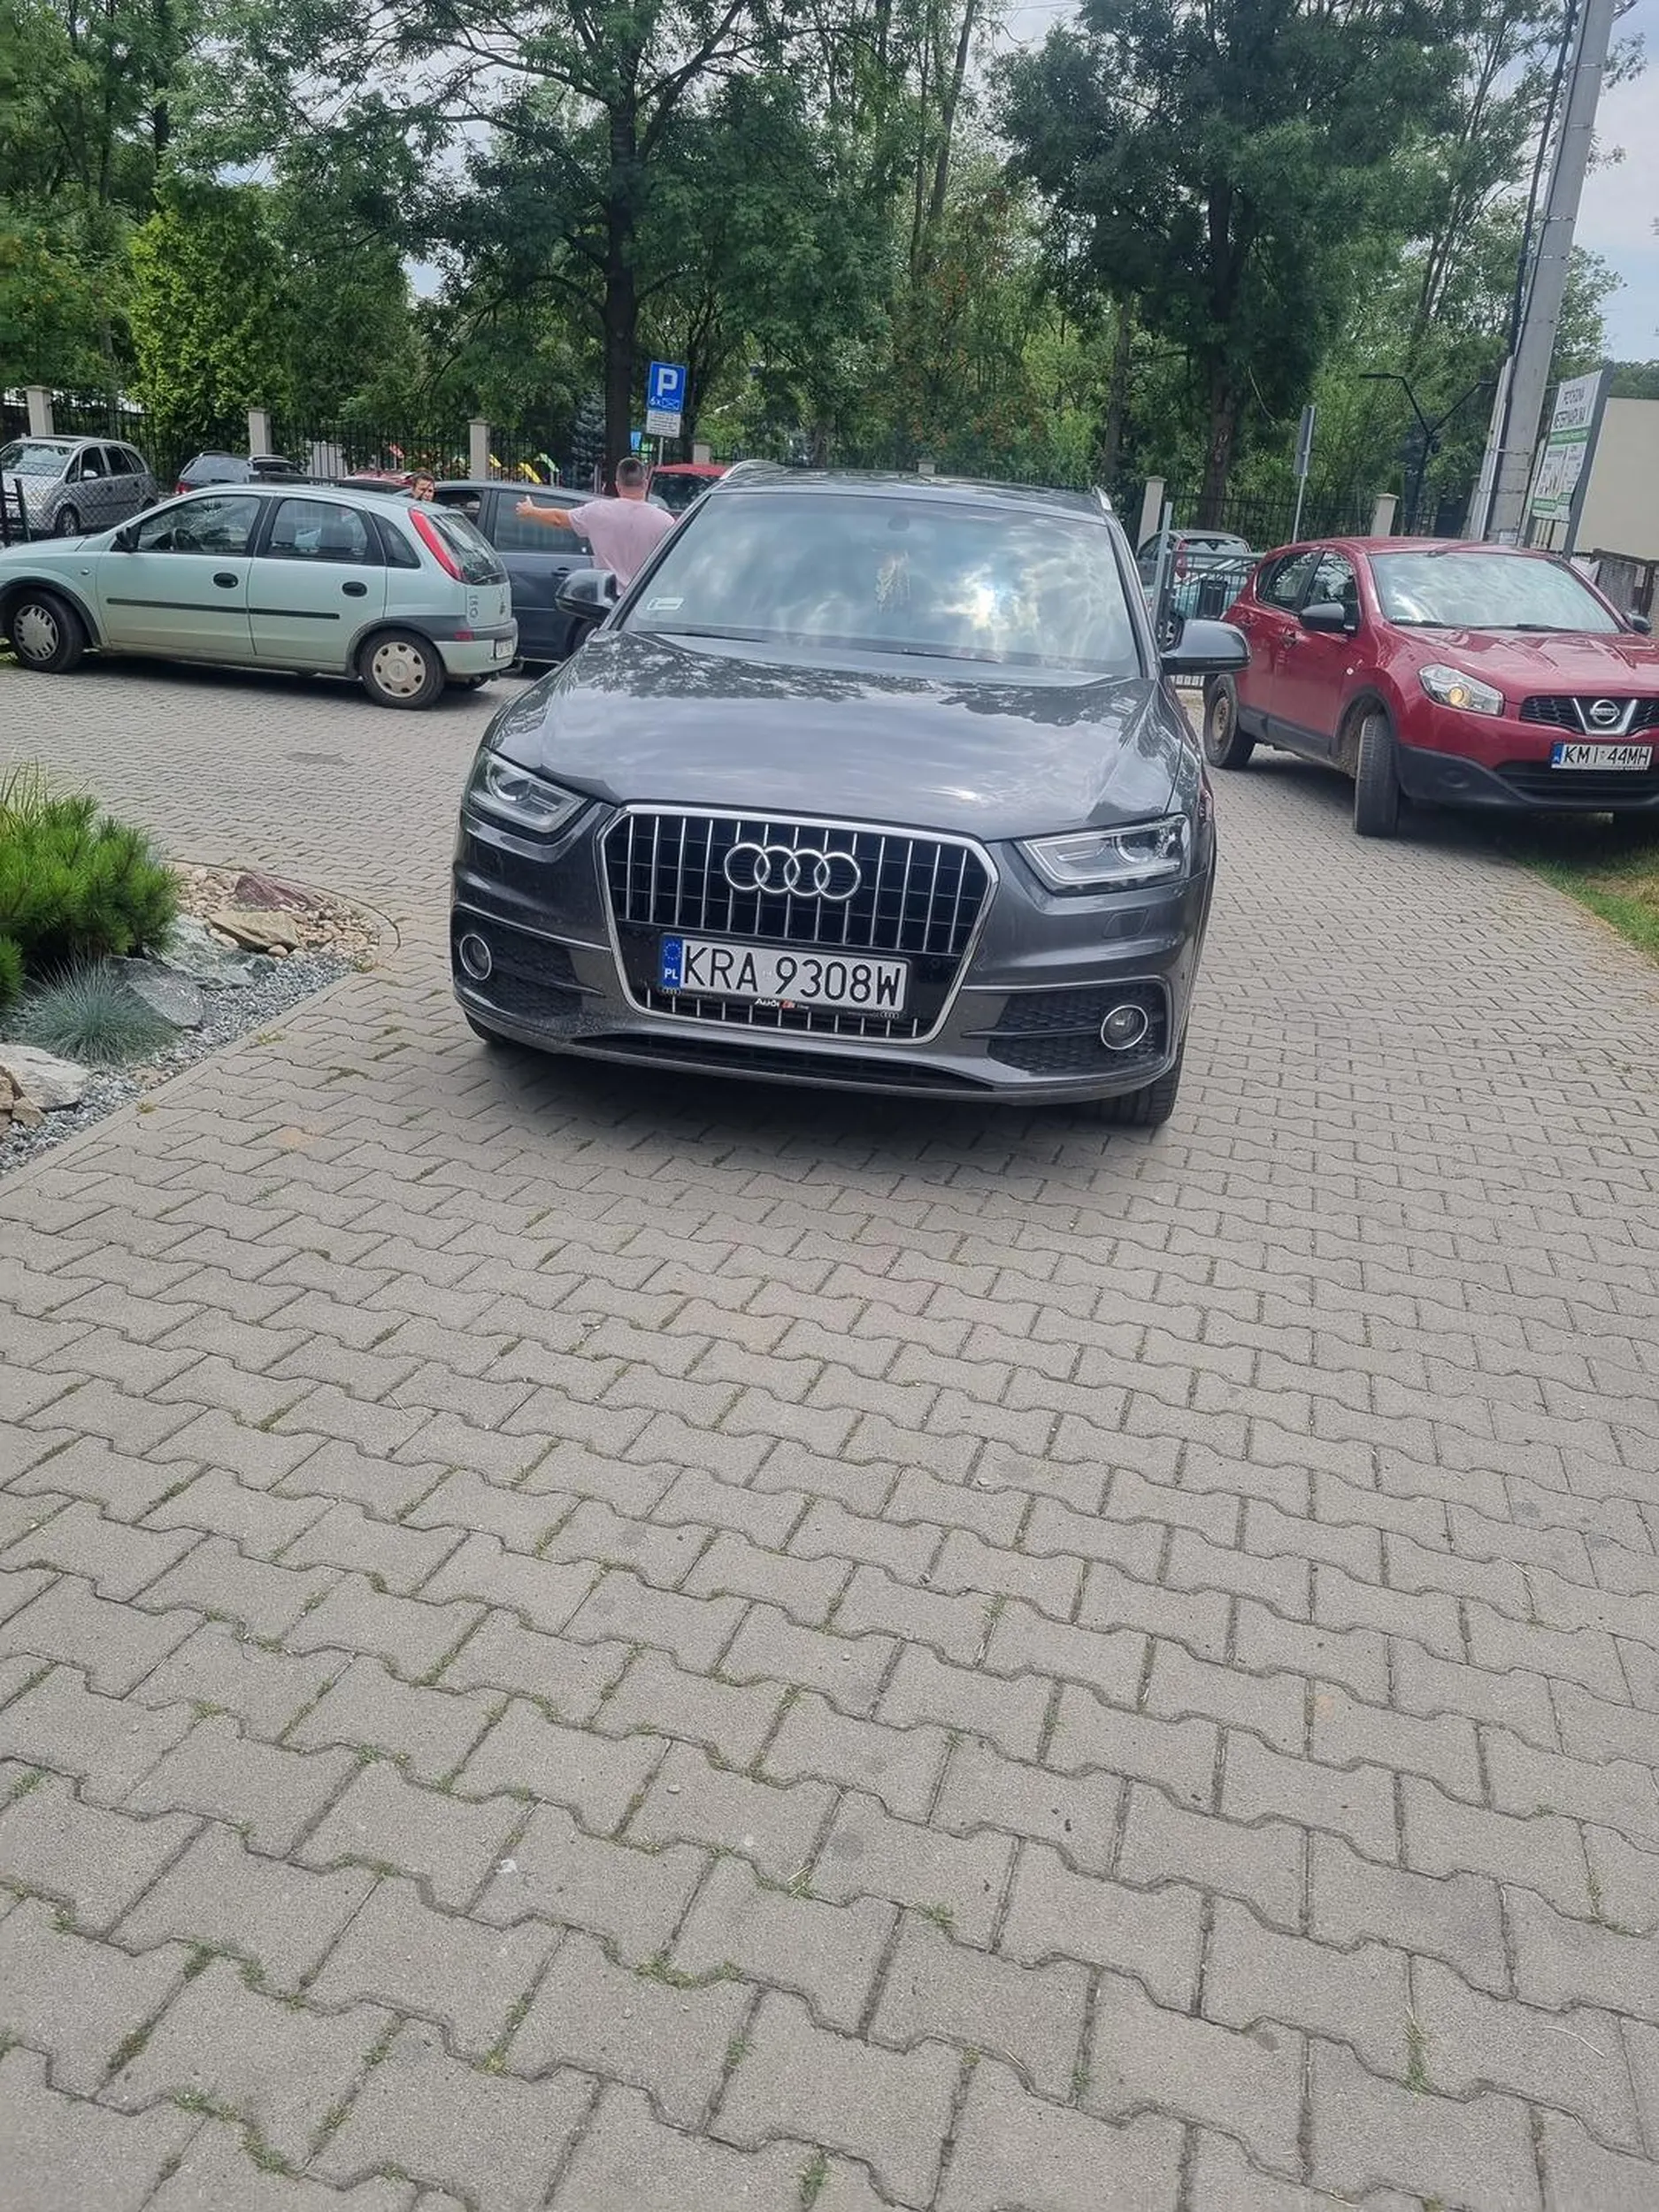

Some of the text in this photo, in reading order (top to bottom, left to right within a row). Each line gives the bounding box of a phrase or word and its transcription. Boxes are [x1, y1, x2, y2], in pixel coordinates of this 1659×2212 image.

[657, 367, 679, 397] P
[1563, 746, 1598, 764] KMI
[1607, 748, 1650, 765] 44MH
[664, 968, 679, 979] PL
[684, 945, 901, 1007] KRA 9308W
